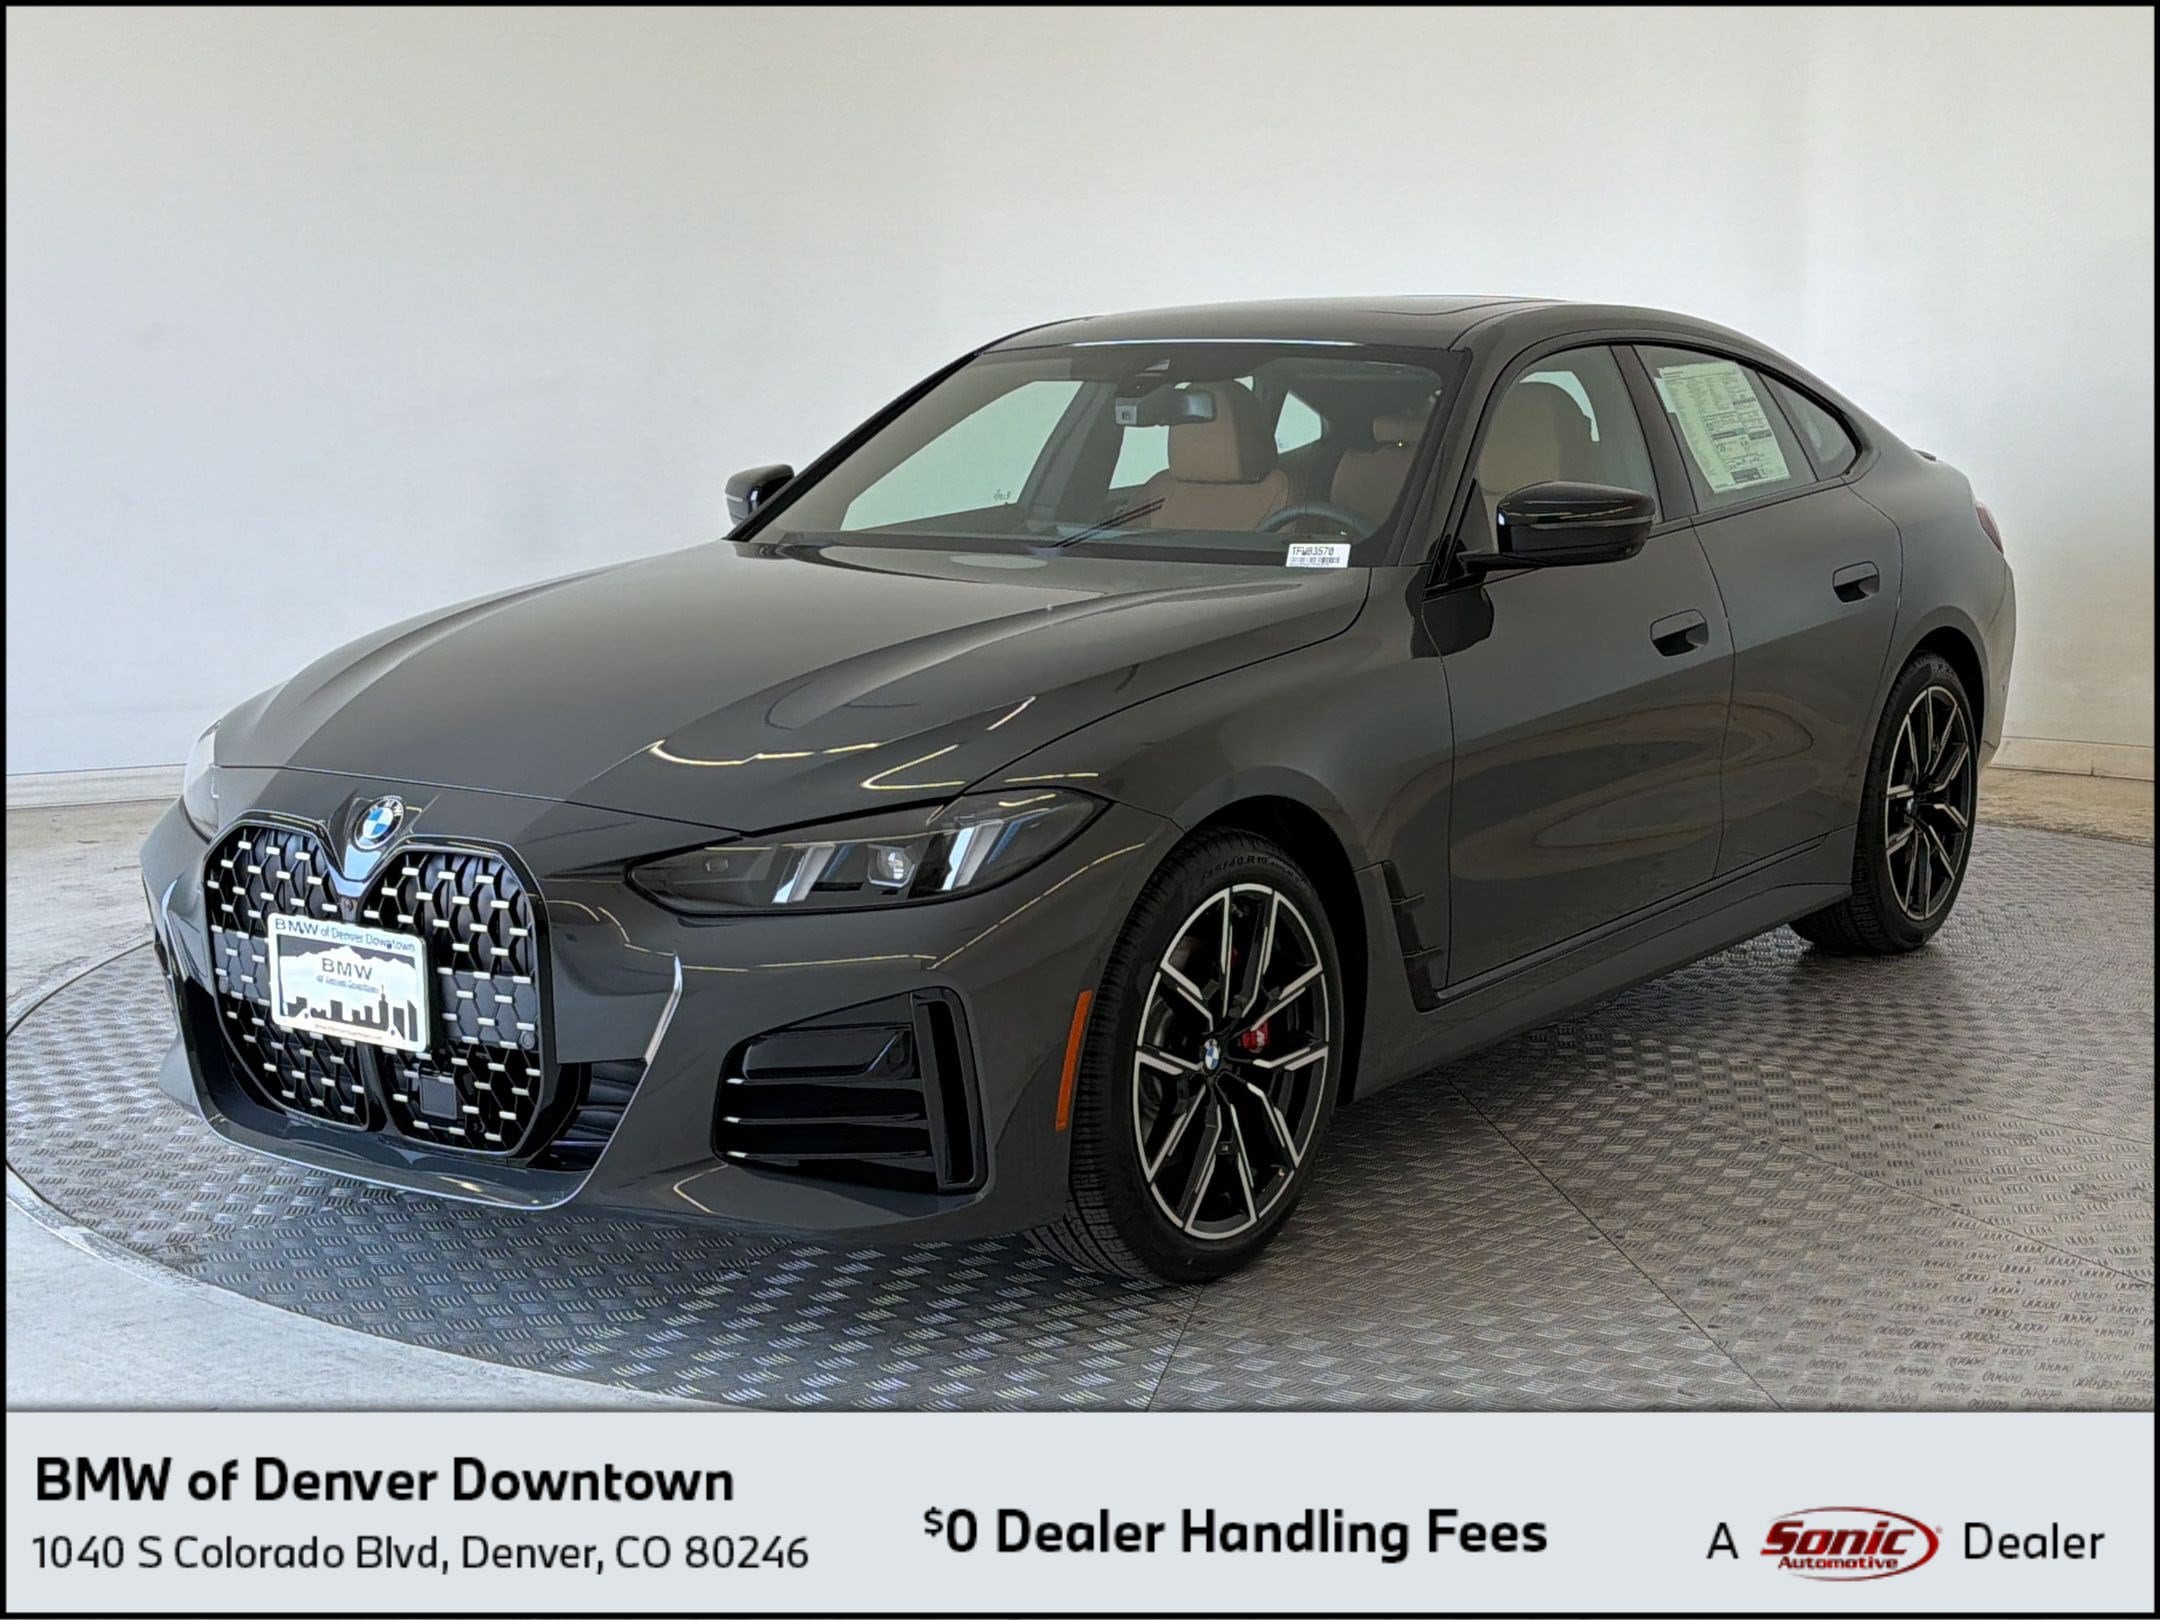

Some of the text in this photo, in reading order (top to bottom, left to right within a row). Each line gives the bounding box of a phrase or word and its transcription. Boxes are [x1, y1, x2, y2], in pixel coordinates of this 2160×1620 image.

[275, 918, 416, 953] BMW of Denver Downtown
[322, 957, 373, 981] BMW
